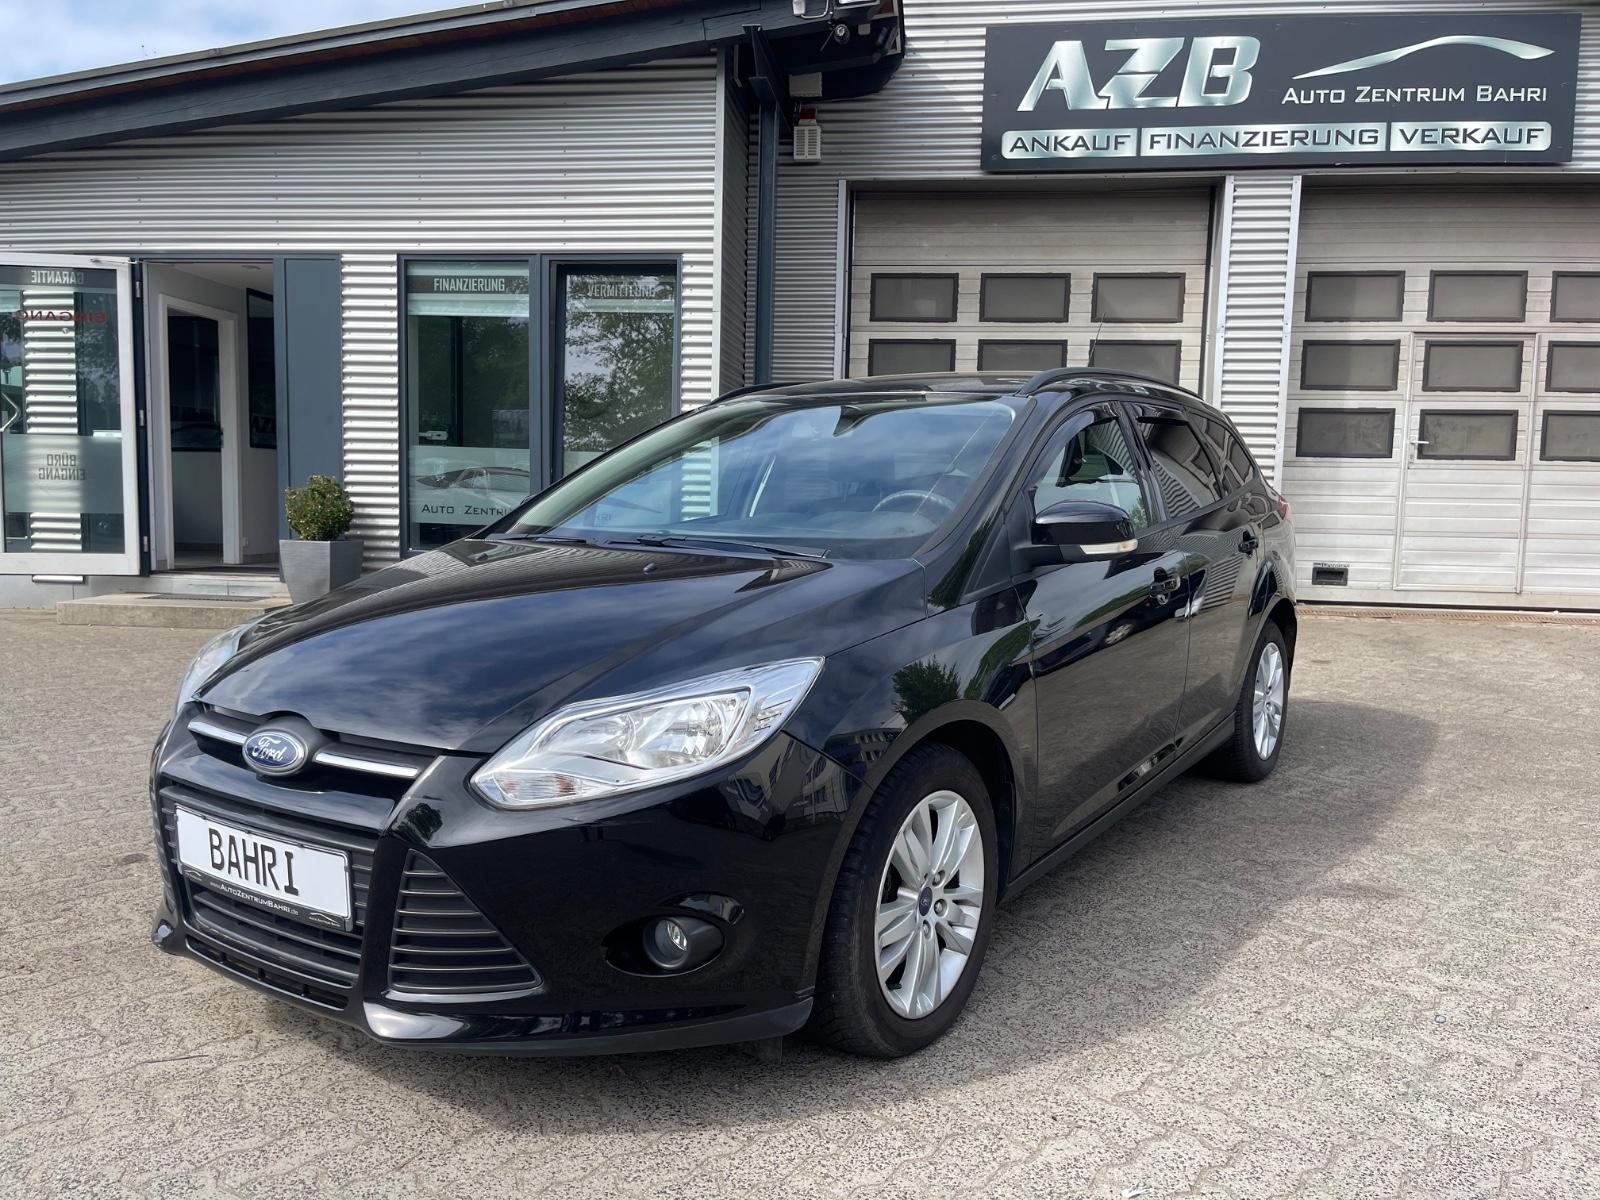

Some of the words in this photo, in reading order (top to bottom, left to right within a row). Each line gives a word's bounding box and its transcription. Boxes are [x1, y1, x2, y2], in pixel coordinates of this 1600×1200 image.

[1017, 36, 1260, 112] AZB
[1282, 87, 1345, 105] AUTO
[1355, 85, 1465, 103] ZENTRUM
[1476, 85, 1547, 102] BAHRI
[1009, 131, 1132, 153] ANKAUF
[1149, 127, 1379, 150] FINANZIERUNG
[1399, 126, 1545, 147] VERKAUF
[433, 277, 505, 293] FINANZIERUNG
[587, 284, 656, 298] VERMITTLUNG
[421, 504, 455, 515] AUTO
[252, 736, 288, 762] Ford
[208, 827, 299, 897] BAHRI
